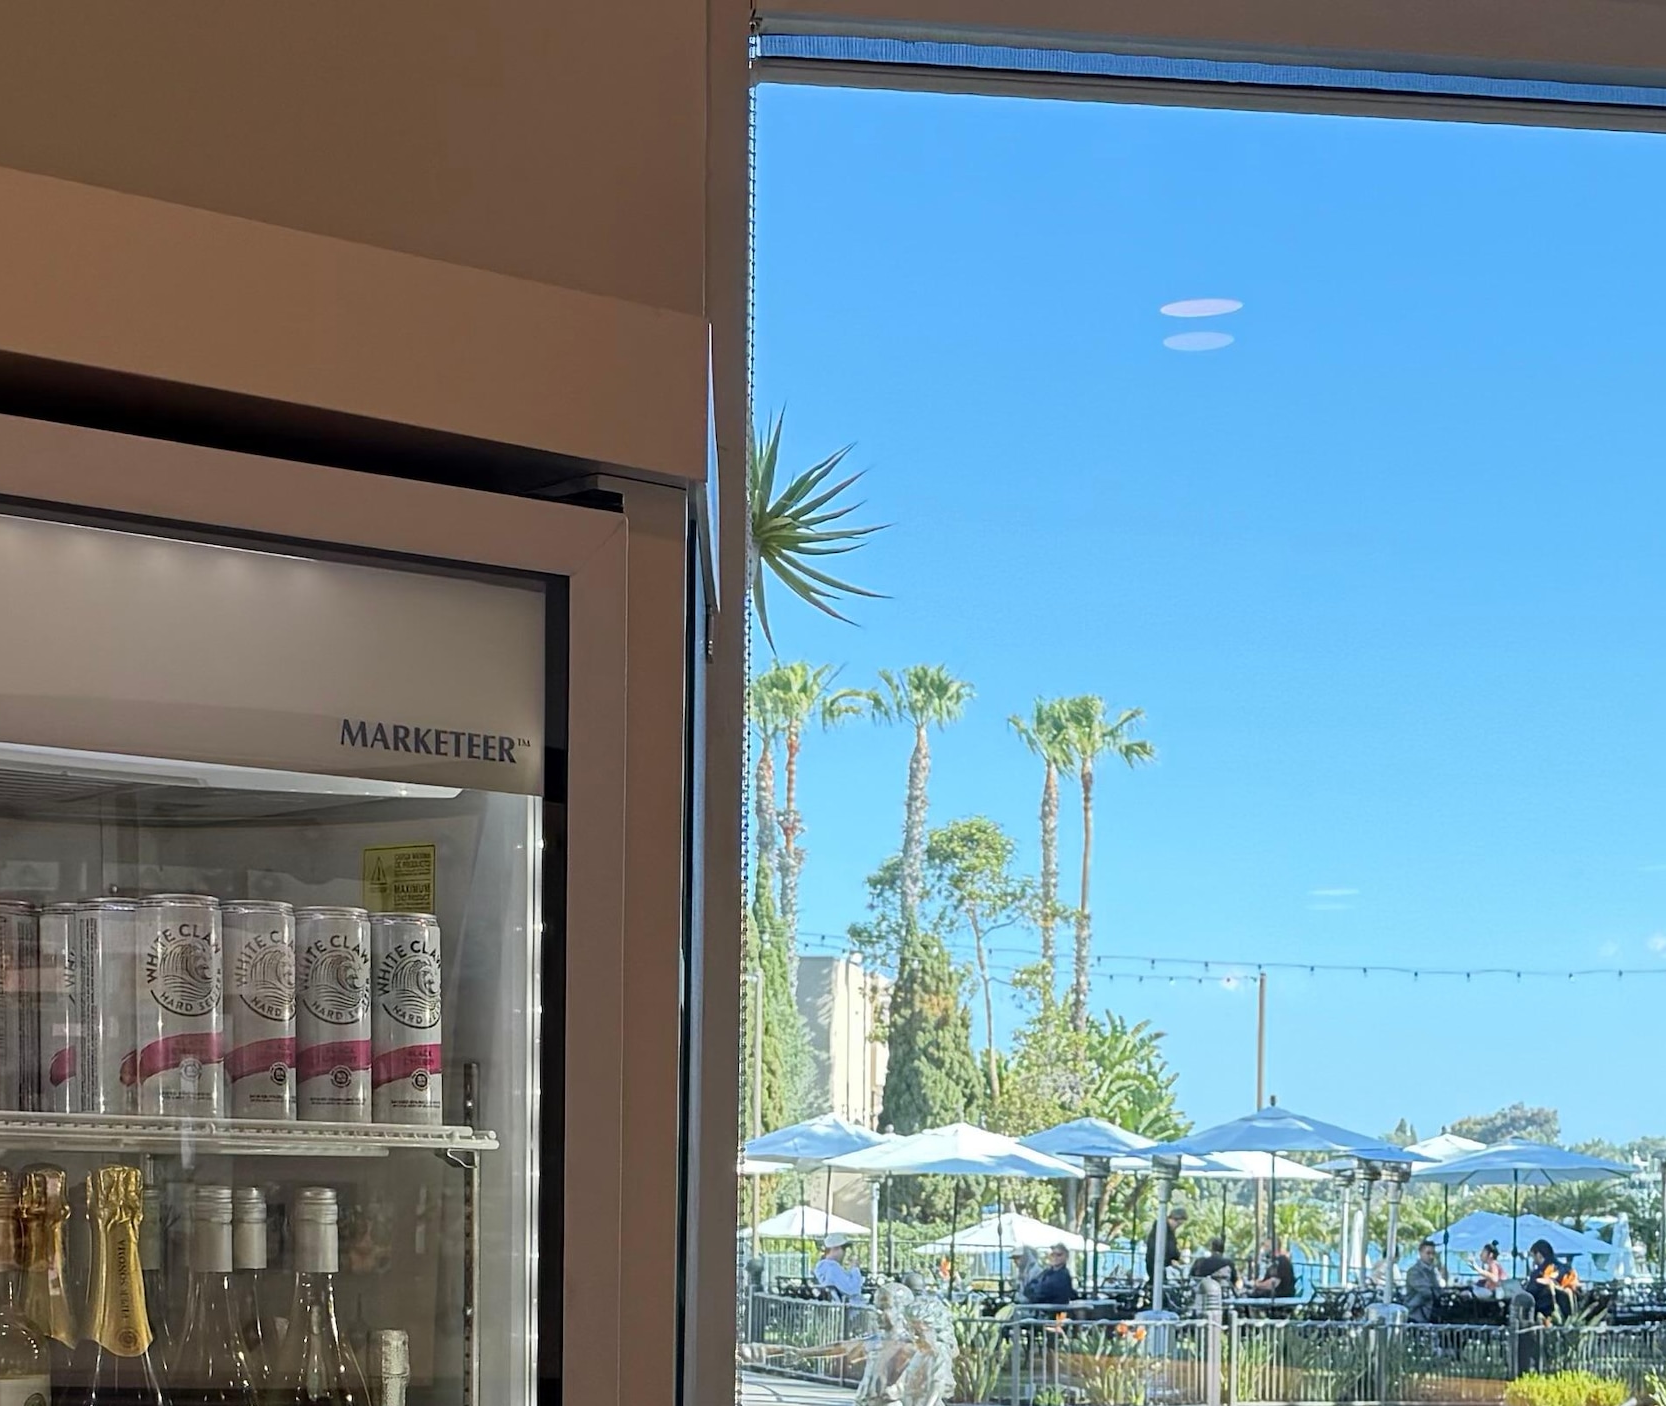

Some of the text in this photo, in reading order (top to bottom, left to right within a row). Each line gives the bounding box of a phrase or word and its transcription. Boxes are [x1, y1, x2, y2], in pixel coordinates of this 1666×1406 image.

[234, 935, 267, 988] WHITE
[378, 945, 408, 997] WHITE
[160, 991, 194, 1012] HARD
[392, 1005, 424, 1025] HARD
